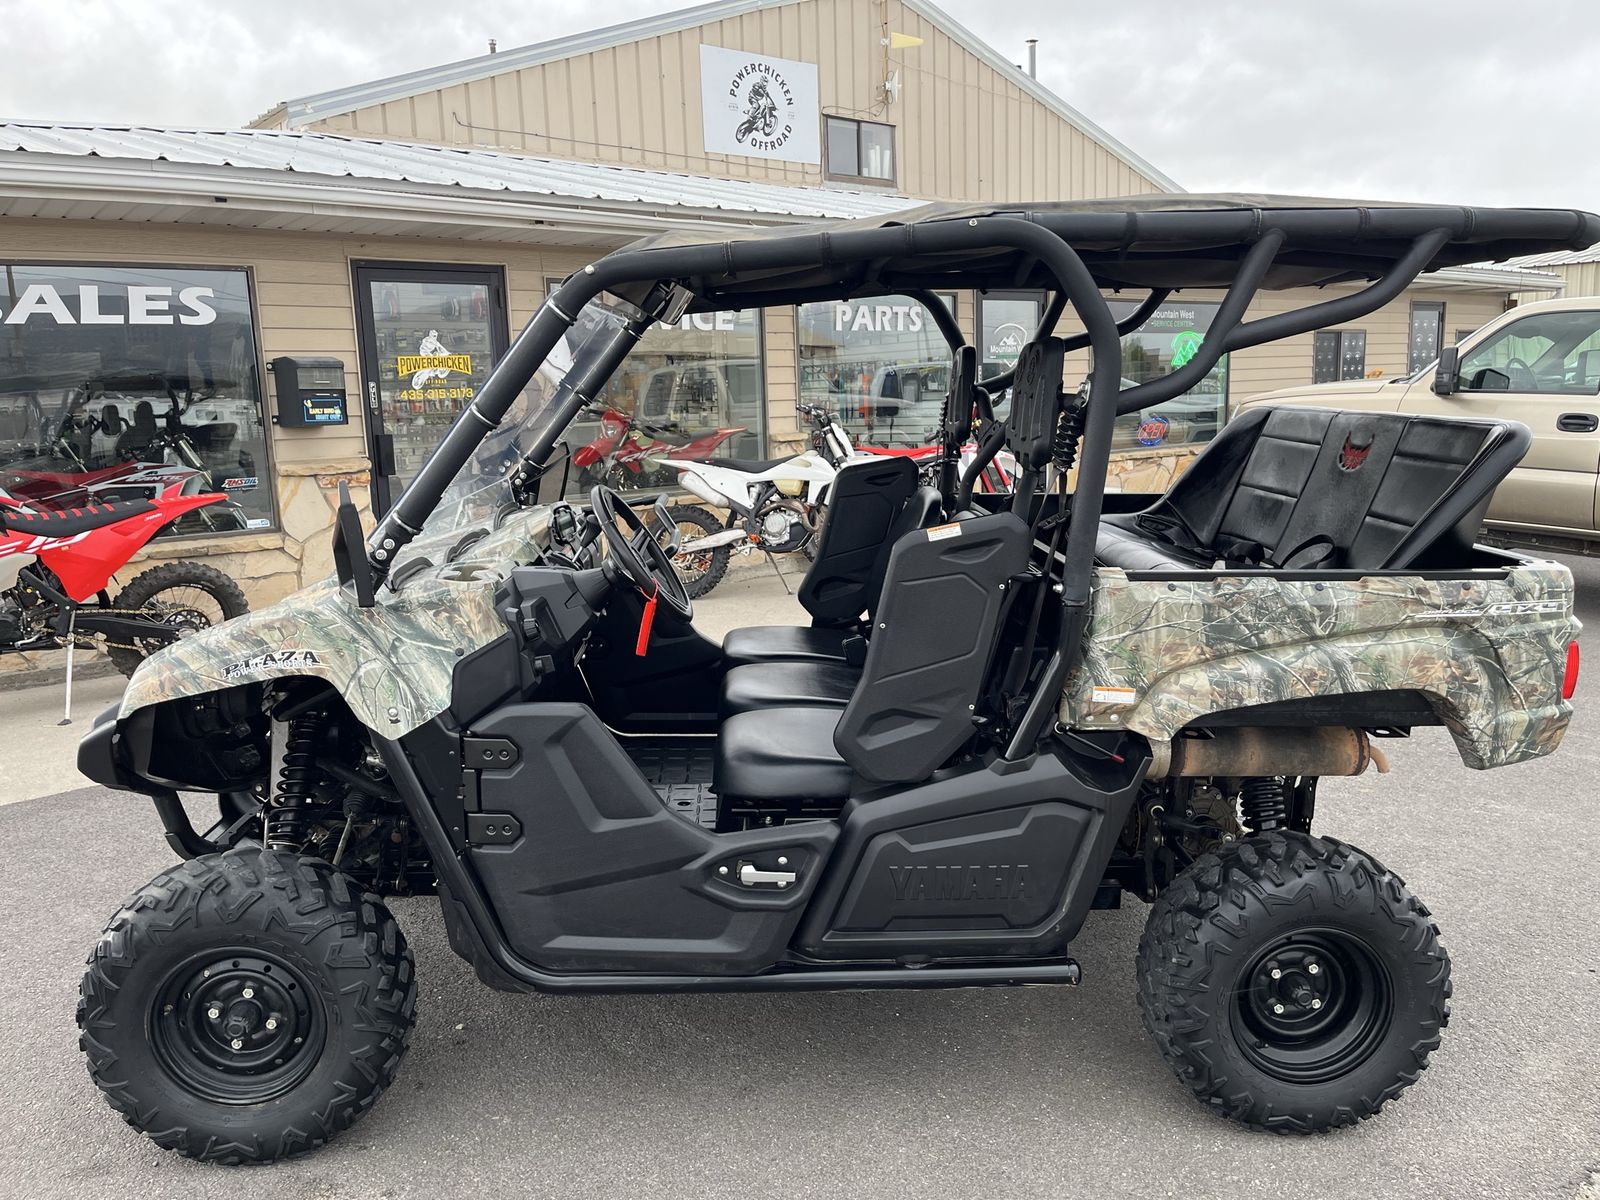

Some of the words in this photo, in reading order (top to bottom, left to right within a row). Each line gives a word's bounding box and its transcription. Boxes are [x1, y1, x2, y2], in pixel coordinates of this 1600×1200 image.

[729, 63, 794, 106] POWERCHICKEN
[751, 124, 792, 150] OFFROAD
[0, 284, 217, 325] ALES
[1180, 310, 1195, 319] West
[835, 304, 922, 332] PARTS
[400, 357, 470, 374] POWERCHICKEN
[1137, 423, 1168, 440] OPEN
[223, 479, 257, 487] AMSOIL
[888, 865, 1033, 901] YAMAHA
